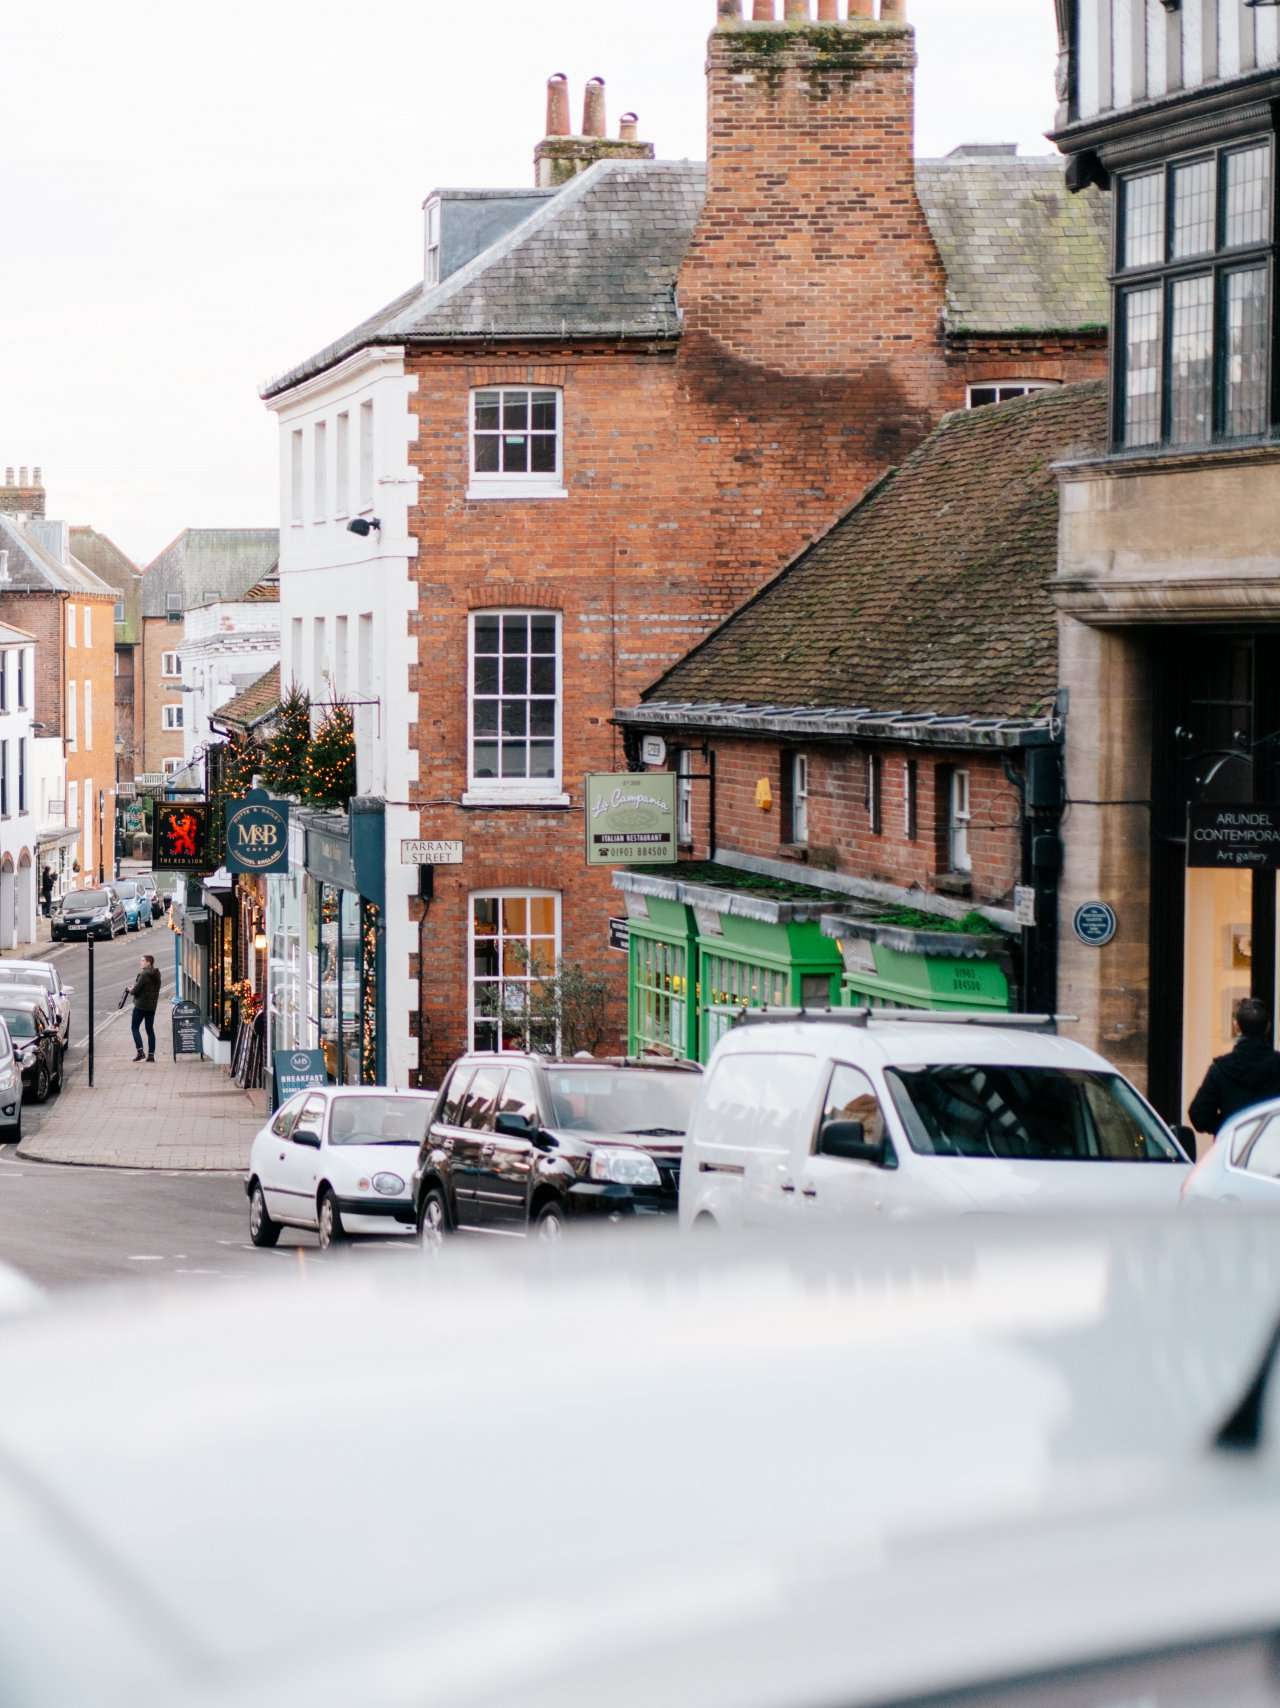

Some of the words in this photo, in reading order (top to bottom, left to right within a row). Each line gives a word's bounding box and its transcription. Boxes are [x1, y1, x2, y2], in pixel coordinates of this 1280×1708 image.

[1216, 813, 1273, 825] ARUNDEL
[237, 824, 277, 845] M&B
[626, 834, 663, 842] RESTAURANT
[404, 841, 460, 851] TARRANT
[610, 848, 633, 857] 01903
[1216, 850, 1234, 860] Art
[1236, 851, 1267, 864] gallery
[412, 853, 452, 862] STREET
[280, 1074, 324, 1083] BREAKFAST
